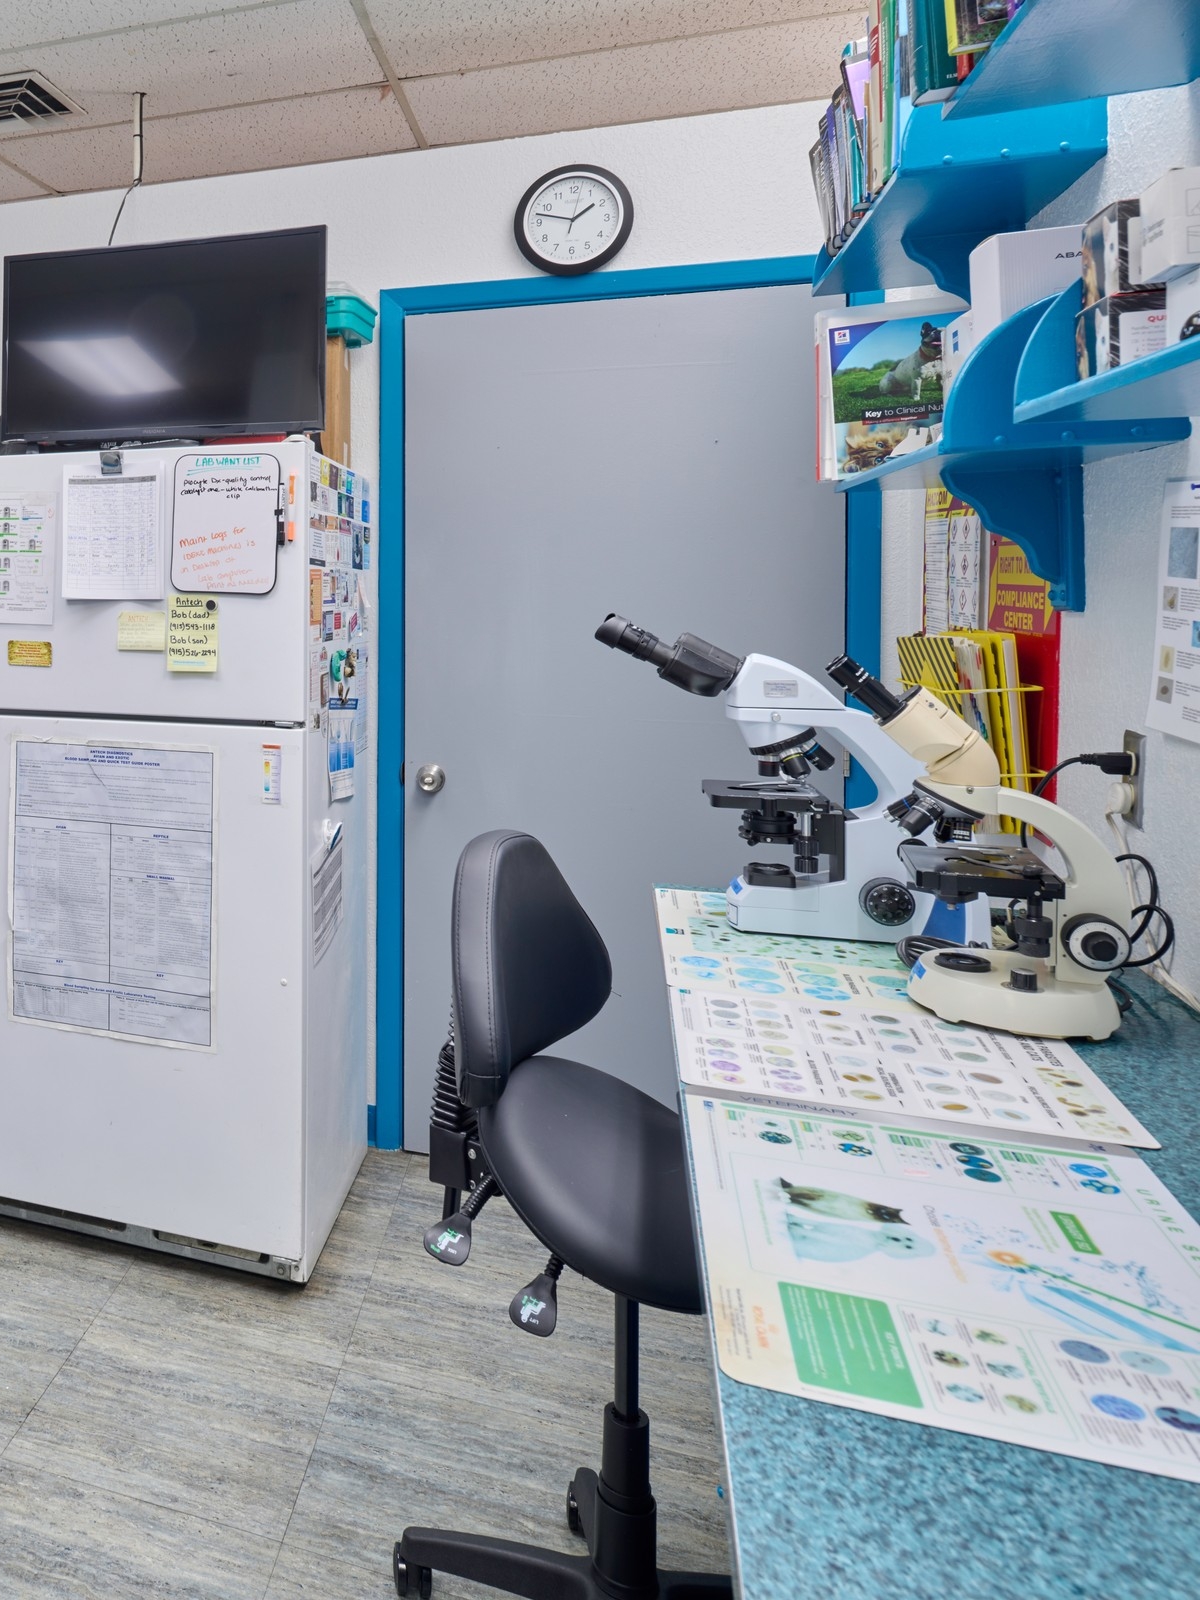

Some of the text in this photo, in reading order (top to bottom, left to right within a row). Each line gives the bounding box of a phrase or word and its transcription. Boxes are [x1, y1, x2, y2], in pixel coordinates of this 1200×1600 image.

[569, 186, 579, 194] 12
[588, 189, 592, 197] 1
[554, 192, 563, 200] 11
[543, 203, 552, 212] 10
[599, 199, 606, 207] 2
[604, 213, 610, 222] 3
[536, 219, 542, 227] 9
[542, 234, 548, 242] 8
[597, 230, 603, 238] 4
[553, 243, 559, 252] 7
[584, 241, 591, 250] 5
[568, 246, 575, 255] 6
[1055, 251, 1083, 259] ABA
[865, 409, 882, 419] Key
[885, 408, 894, 416] to
[896, 404, 925, 415] Clinical
[196, 456, 262, 467] LAB WANT LIST
[233, 526, 246, 535] for
[999, 555, 1014, 575] RIGHT
[1016, 556, 1023, 574] TO
[176, 597, 203, 606] Antech
[997, 590, 1044, 610] COMPLIANCE
[1003, 610, 1033, 630] CENTER
[1033, 1045, 1066, 1067] PARASITES
[1136, 1188, 1184, 1234] URINE
